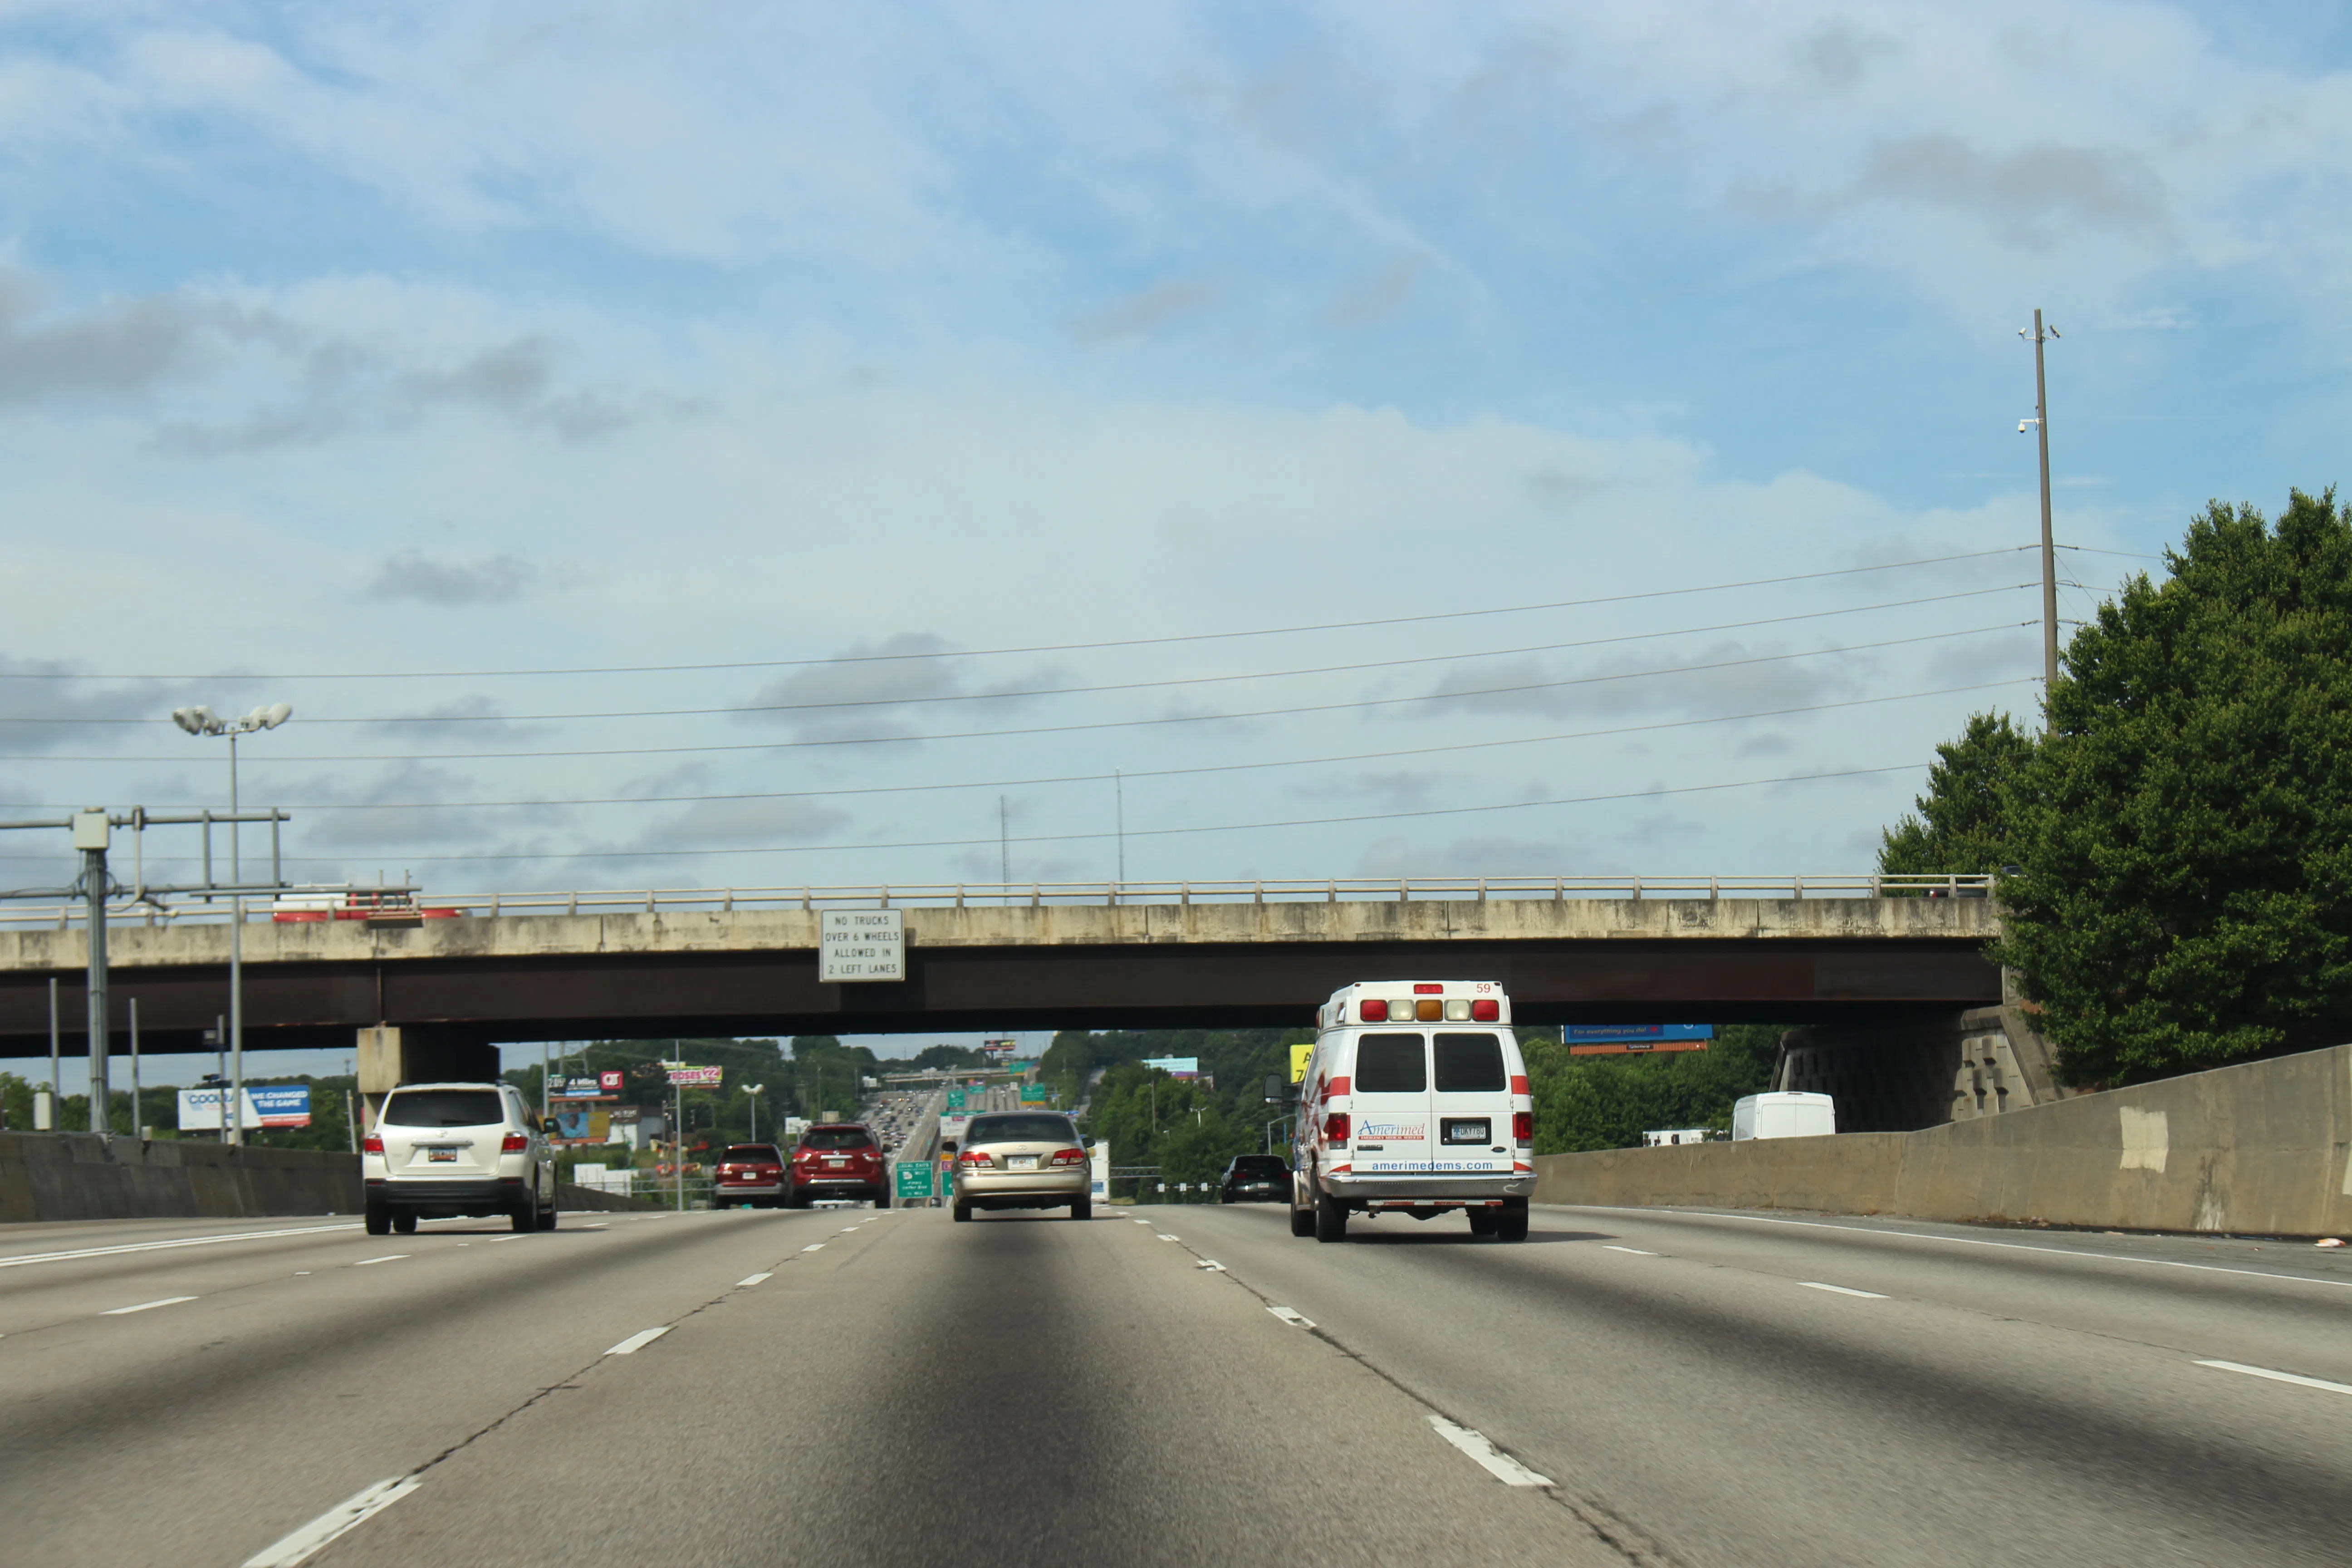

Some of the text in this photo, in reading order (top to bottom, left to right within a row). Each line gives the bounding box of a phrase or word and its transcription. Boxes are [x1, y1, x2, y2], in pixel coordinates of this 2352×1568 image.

[835, 916, 889, 926] NO TRUCKS
[825, 932, 899, 941] OVER 6 WHEELS
[834, 948, 891, 958] ALLOWED IN
[828, 964, 897, 974] 2 LEFT LANES
[1477, 983, 1490, 993] 59
[1357, 1119, 1425, 1135] Amerimed
[1460, 1127, 1484, 1135] DKY780
[1372, 1161, 1493, 1170] amerimedems.com
